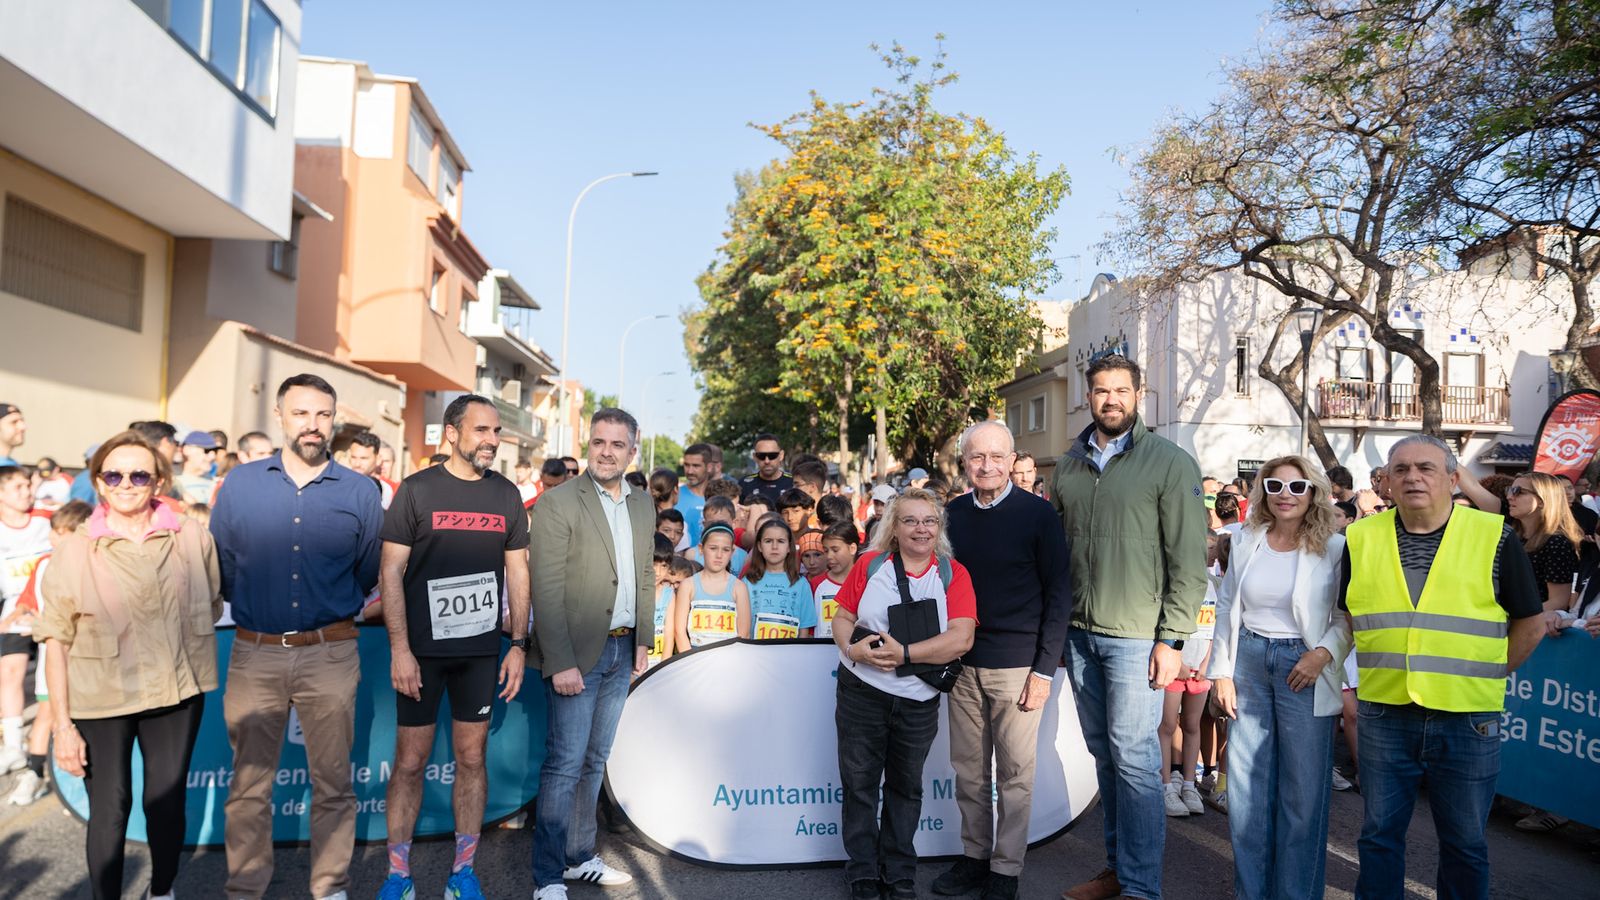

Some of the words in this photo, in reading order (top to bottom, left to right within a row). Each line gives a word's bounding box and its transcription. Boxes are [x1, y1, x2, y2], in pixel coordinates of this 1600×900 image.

[436, 513, 504, 529] アシックス
[436, 590, 494, 618] 2014
[693, 613, 734, 631] 1141
[1505, 672, 1533, 700] de
[1538, 716, 1600, 764] Este
[795, 815, 838, 836] Área
